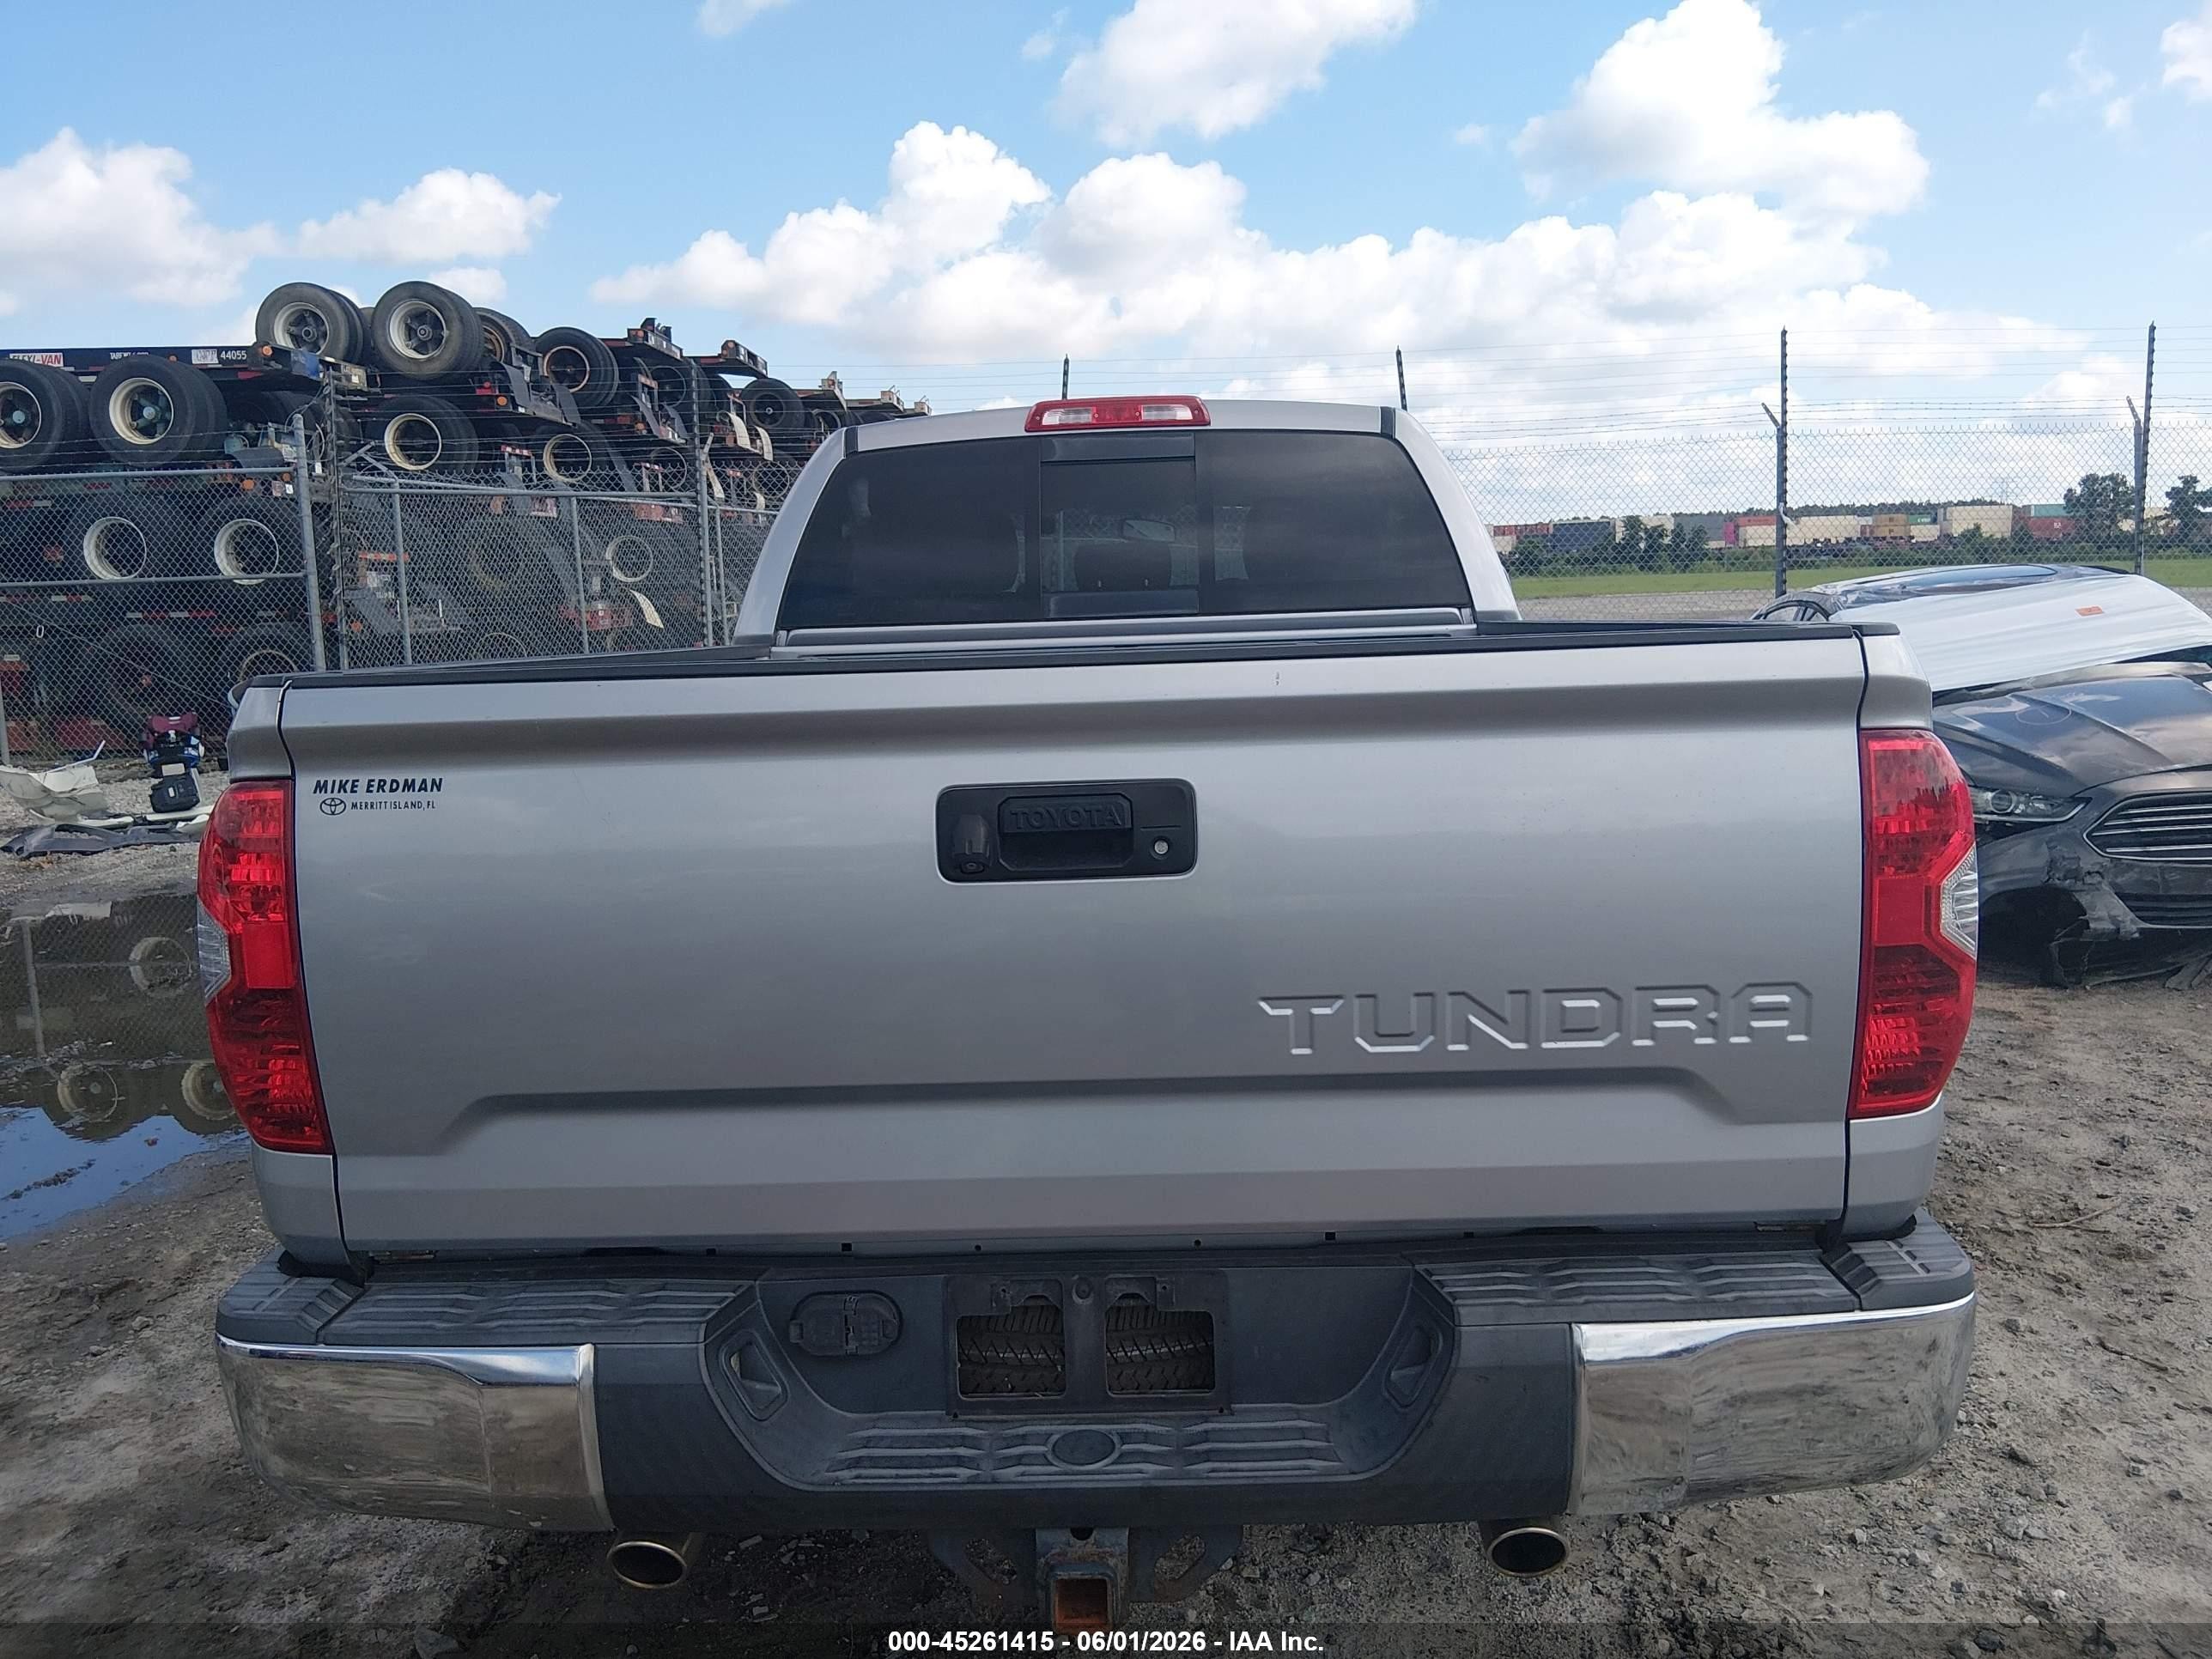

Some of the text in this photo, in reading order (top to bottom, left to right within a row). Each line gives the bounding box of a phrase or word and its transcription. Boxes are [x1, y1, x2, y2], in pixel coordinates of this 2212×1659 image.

[221, 349, 247, 360] 44055
[313, 777, 443, 794] MIKE ERDMAN
[350, 799, 435, 811] MERRITT ISLAND, FL
[1010, 805, 1121, 830] TOYOTA
[1257, 981, 1813, 1056] TUNDRA
